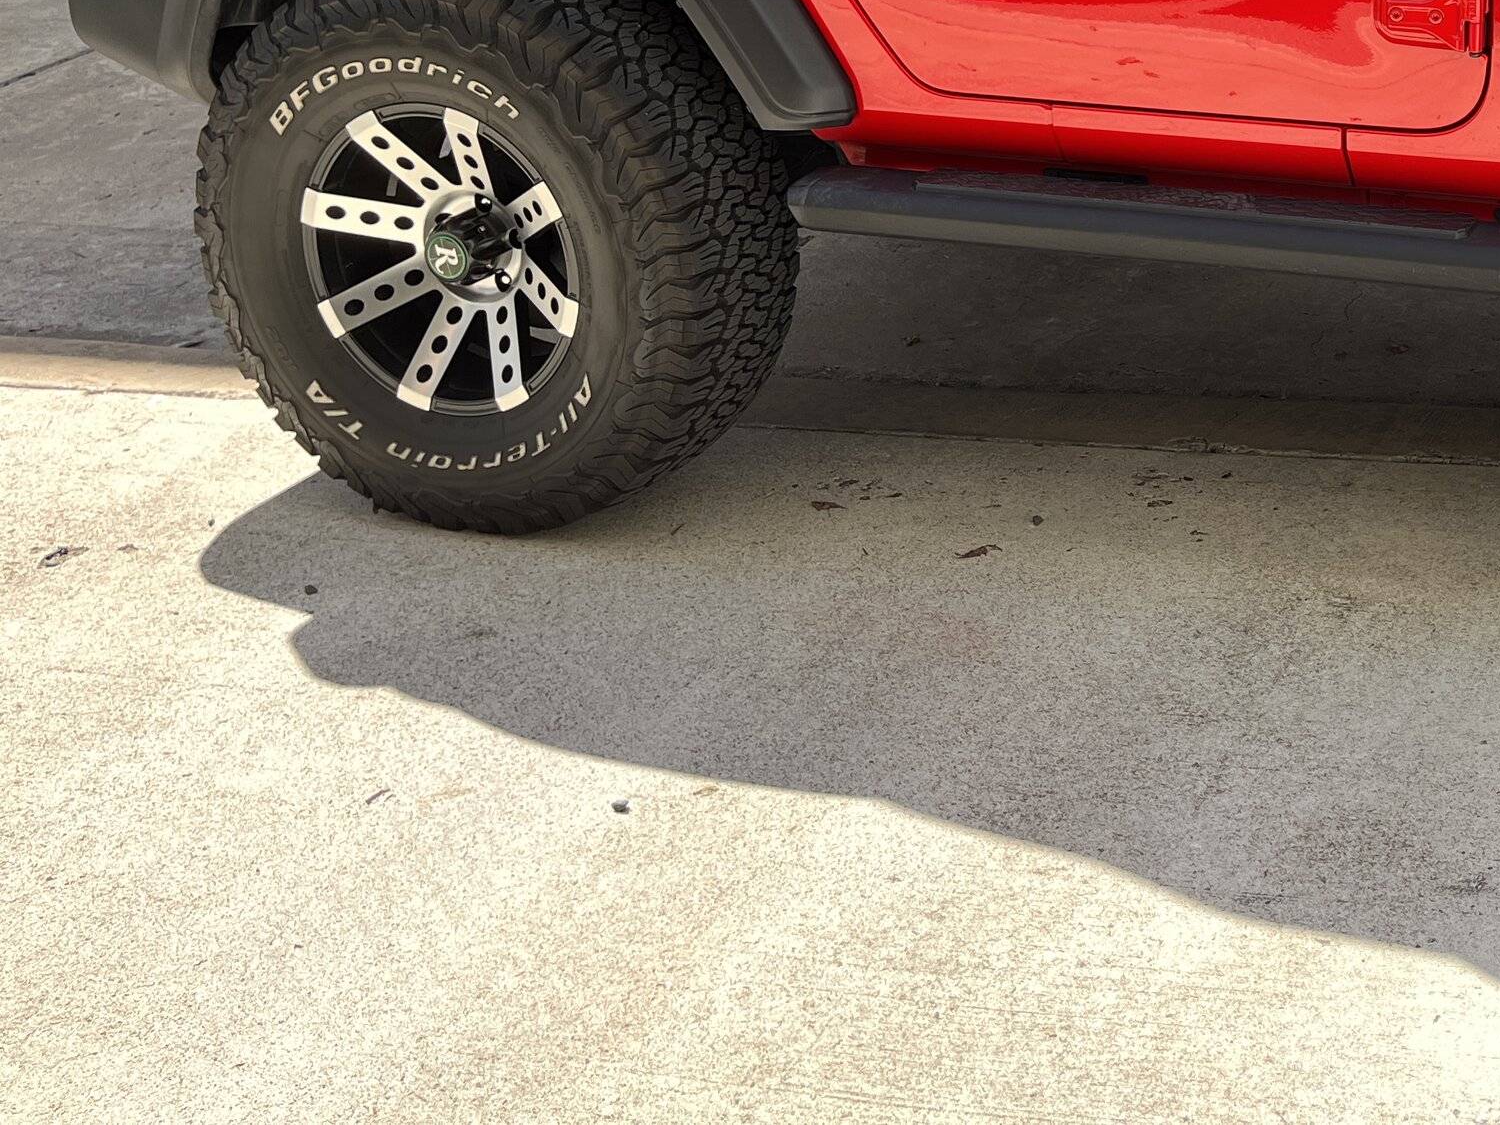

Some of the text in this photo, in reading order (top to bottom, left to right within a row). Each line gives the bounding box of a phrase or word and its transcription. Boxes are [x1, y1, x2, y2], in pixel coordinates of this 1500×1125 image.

[268, 56, 521, 137] BFGoodrich
[434, 243, 459, 275] R
[305, 372, 593, 472] All-Terrain T/A
